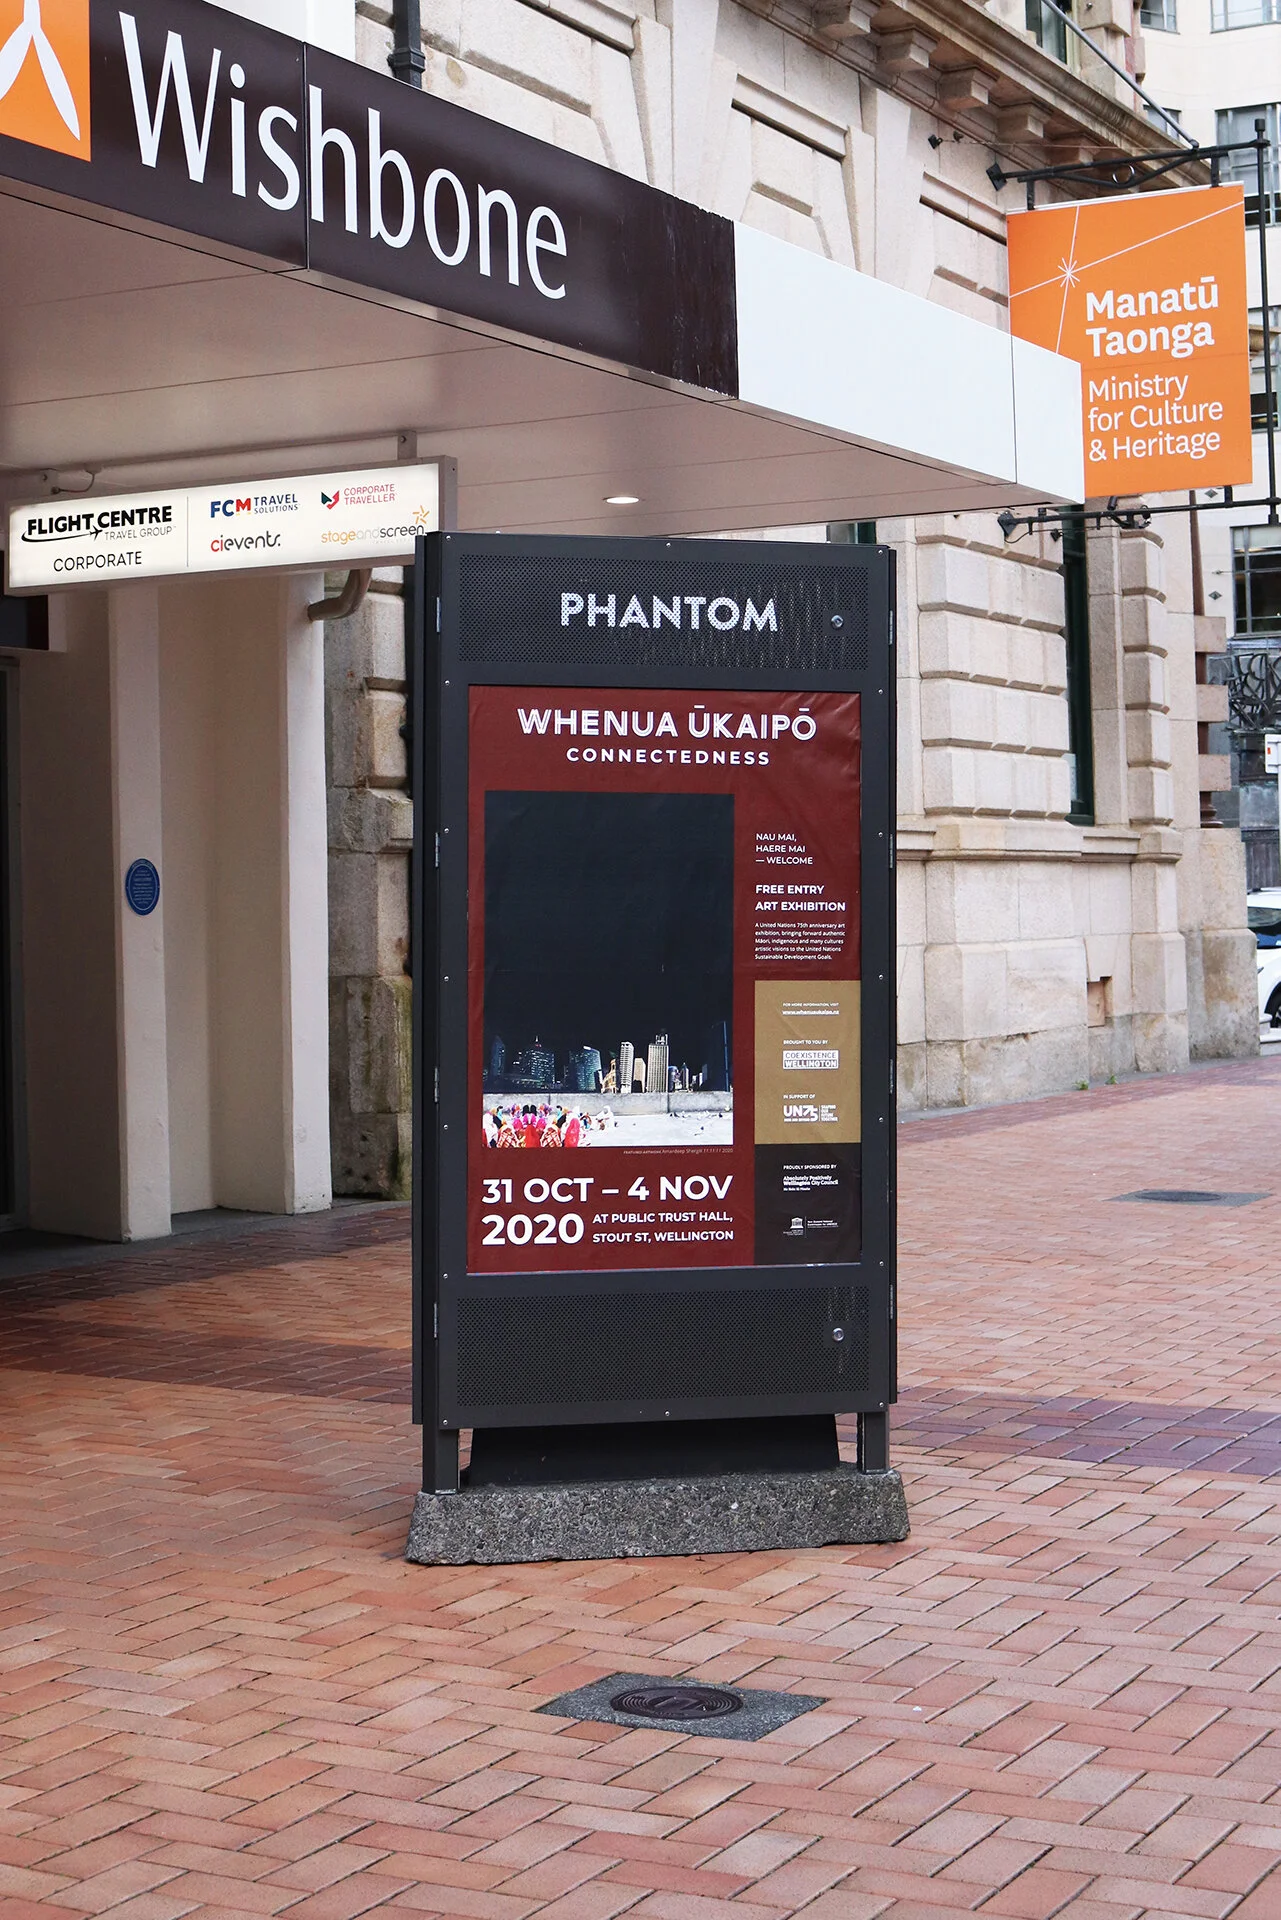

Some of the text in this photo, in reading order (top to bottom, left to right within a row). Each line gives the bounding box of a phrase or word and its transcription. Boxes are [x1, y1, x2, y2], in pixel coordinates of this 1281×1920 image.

[119, 11, 568, 299] Wishbone
[1085, 275, 1219, 322] Manatū
[1085, 321, 1215, 358] Taonga
[1088, 373, 1189, 403] Ministry
[1088, 400, 1223, 433] for Culture
[1088, 431, 1221, 462] & Heritage
[253, 493, 298, 506] TRAVEL
[343, 483, 395, 497] CORPORATE
[344, 493, 396, 505] TRAVELLER
[210, 498, 252, 518] FCM
[254, 503, 299, 514] SOLUTIONS
[27, 505, 173, 535] FLIGHT CENTRE
[105, 526, 173, 541] TRAVEL GROUP
[53, 551, 142, 572] CORPORATE
[560, 592, 779, 632] PHANTOM
[517, 705, 817, 741] WHENUA ŪKAIPŌ
[566, 747, 770, 766] CONNECTEDNESS
[756, 833, 797, 842] NAU MAI,
[755, 845, 806, 853] HAERE MAI
[766, 856, 813, 865] WELCOME
[755, 885, 825, 895] FREE ENTRY
[755, 901, 846, 912] ART EXHIBITION
[783, 1104, 818, 1122] UN75
[481, 1178, 513, 1204] 31
[523, 1177, 594, 1203] OCT
[627, 1177, 649, 1201] 4
[659, 1175, 734, 1201] NOV
[592, 1211, 733, 1223] AT PUBLIC TRUST HALL,
[481, 1213, 584, 1245] 2020
[592, 1230, 734, 1243] STOUT ST, WELLINGTON
